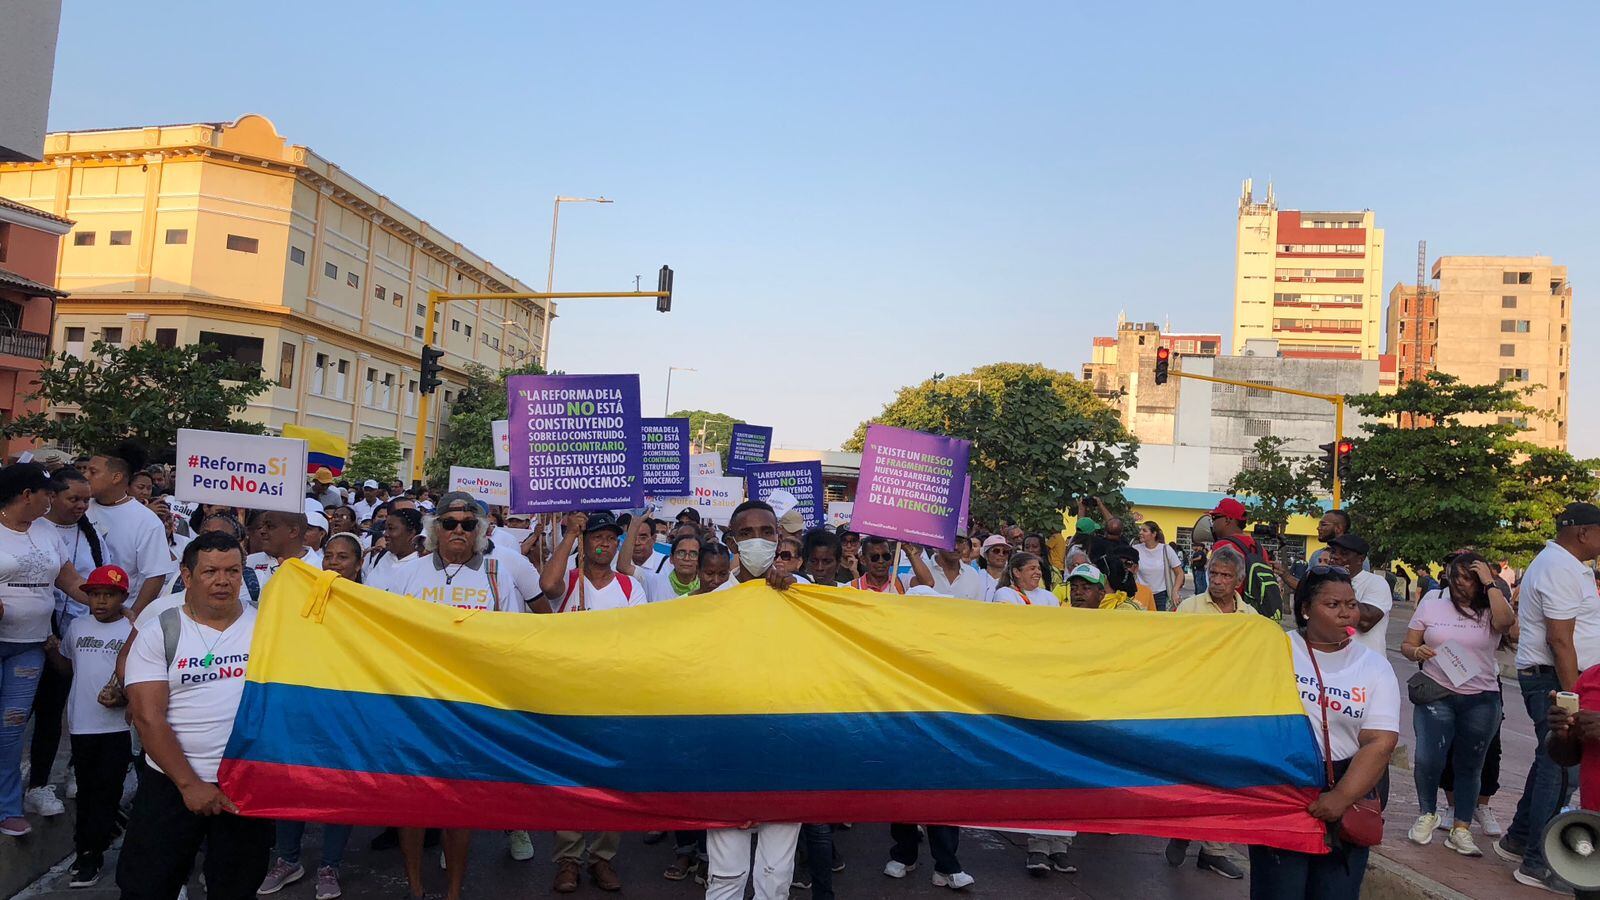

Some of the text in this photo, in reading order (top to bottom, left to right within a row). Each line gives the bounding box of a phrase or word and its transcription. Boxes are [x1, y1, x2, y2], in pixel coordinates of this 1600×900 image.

[541, 390, 594, 400] REFORMA
[595, 389, 608, 400] DE
[610, 389, 622, 400] LA
[528, 400, 624, 416] SALUD NO ESTÁ
[528, 417, 624, 430] CONSTRUYENDO
[528, 430, 627, 441] SOBRE LO CONSTRUIDO.
[647, 434, 663, 442] NO
[664, 432, 680, 441] ESTÁ
[529, 441, 628, 452] TODO LO CONTRARIO,
[529, 453, 626, 466] ESTÁ DESTRUYENDO
[907, 451, 920, 461] UN
[921, 454, 953, 466] RIESGO
[530, 465, 626, 478] EL SISTEMA DE SALUD
[876, 456, 954, 478] DE FRAGMENTACIÓN,
[780, 478, 796, 486] NO
[798, 475, 813, 484] ESTÁ
[874, 466, 950, 486] NUEVAS BARRERAS DE
[530, 478, 554, 491] QUE
[873, 475, 900, 485] ACCESO
[907, 481, 950, 495] AFECTACIÓN
[869, 494, 882, 504] DE
[883, 496, 895, 506] LA
[882, 486, 891, 494] LA
[892, 488, 948, 504] INTEGRALIDAD
[452, 587, 488, 603] EPS
[76, 637, 104, 648] Nike
